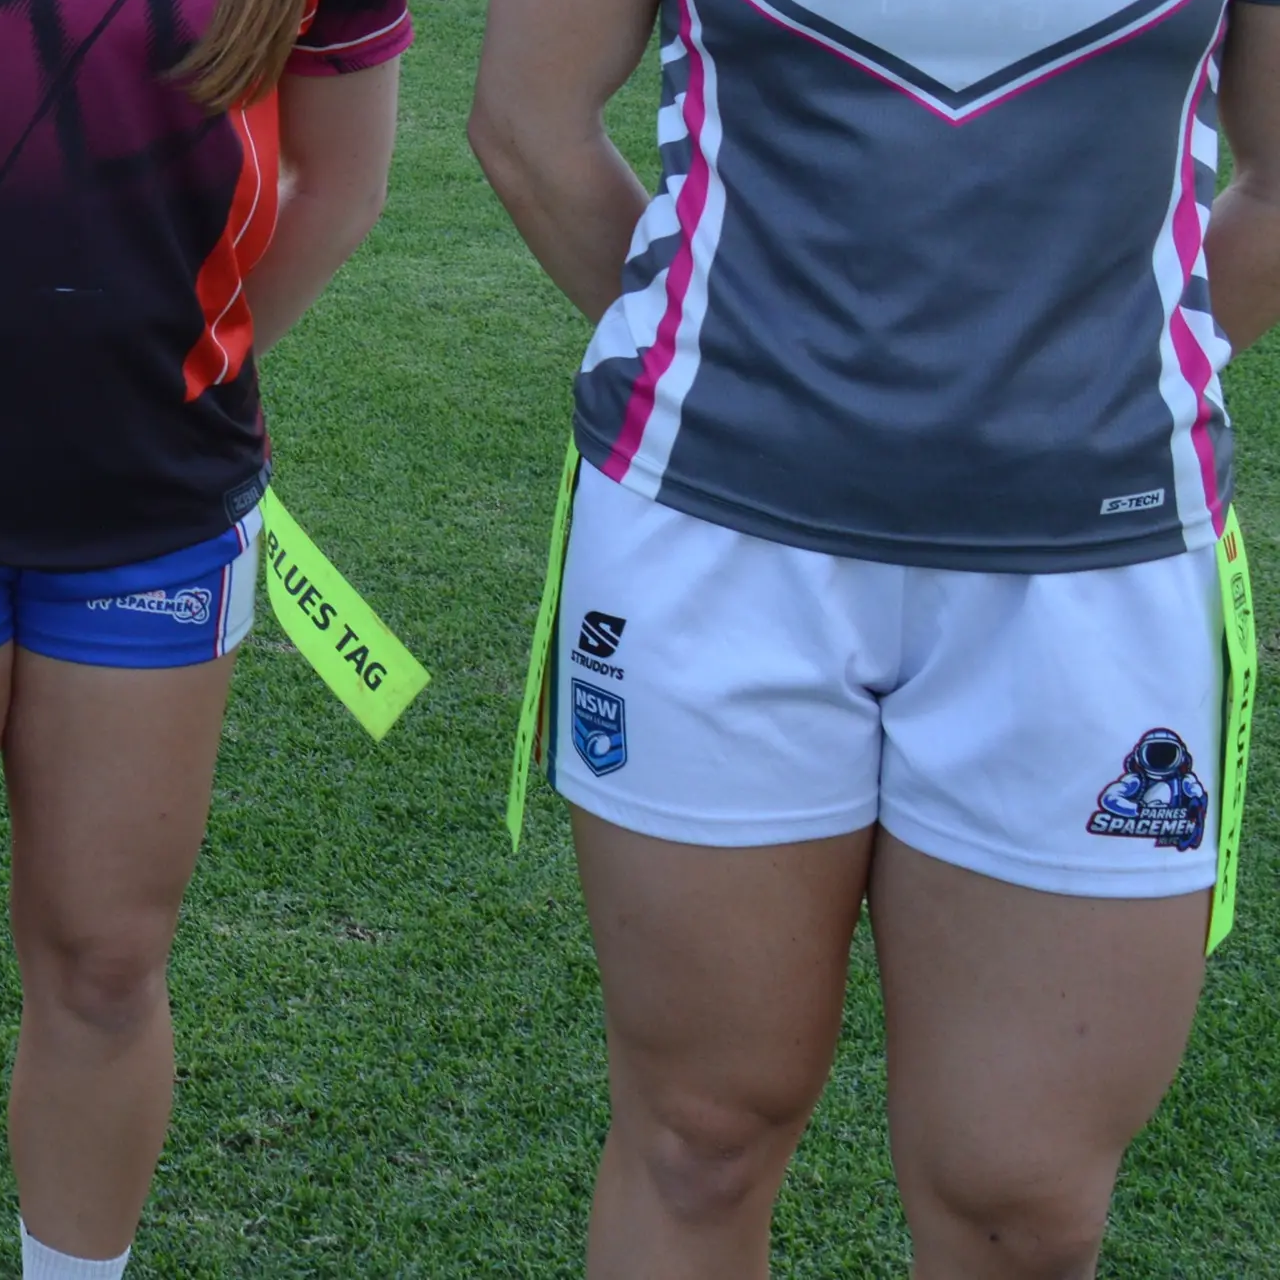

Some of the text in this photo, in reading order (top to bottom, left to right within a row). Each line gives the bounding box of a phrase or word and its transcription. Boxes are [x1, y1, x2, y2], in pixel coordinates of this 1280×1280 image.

[1106, 493, 1160, 512] S-TECH
[119, 595, 193, 613] SPACEMEN
[267, 529, 388, 692] BLUES TAG
[571, 648, 625, 681] STRUDDYS
[575, 686, 618, 721] NSW
[1140, 807, 1188, 818] PARKES
[1090, 813, 1196, 836] SPACEMEN
